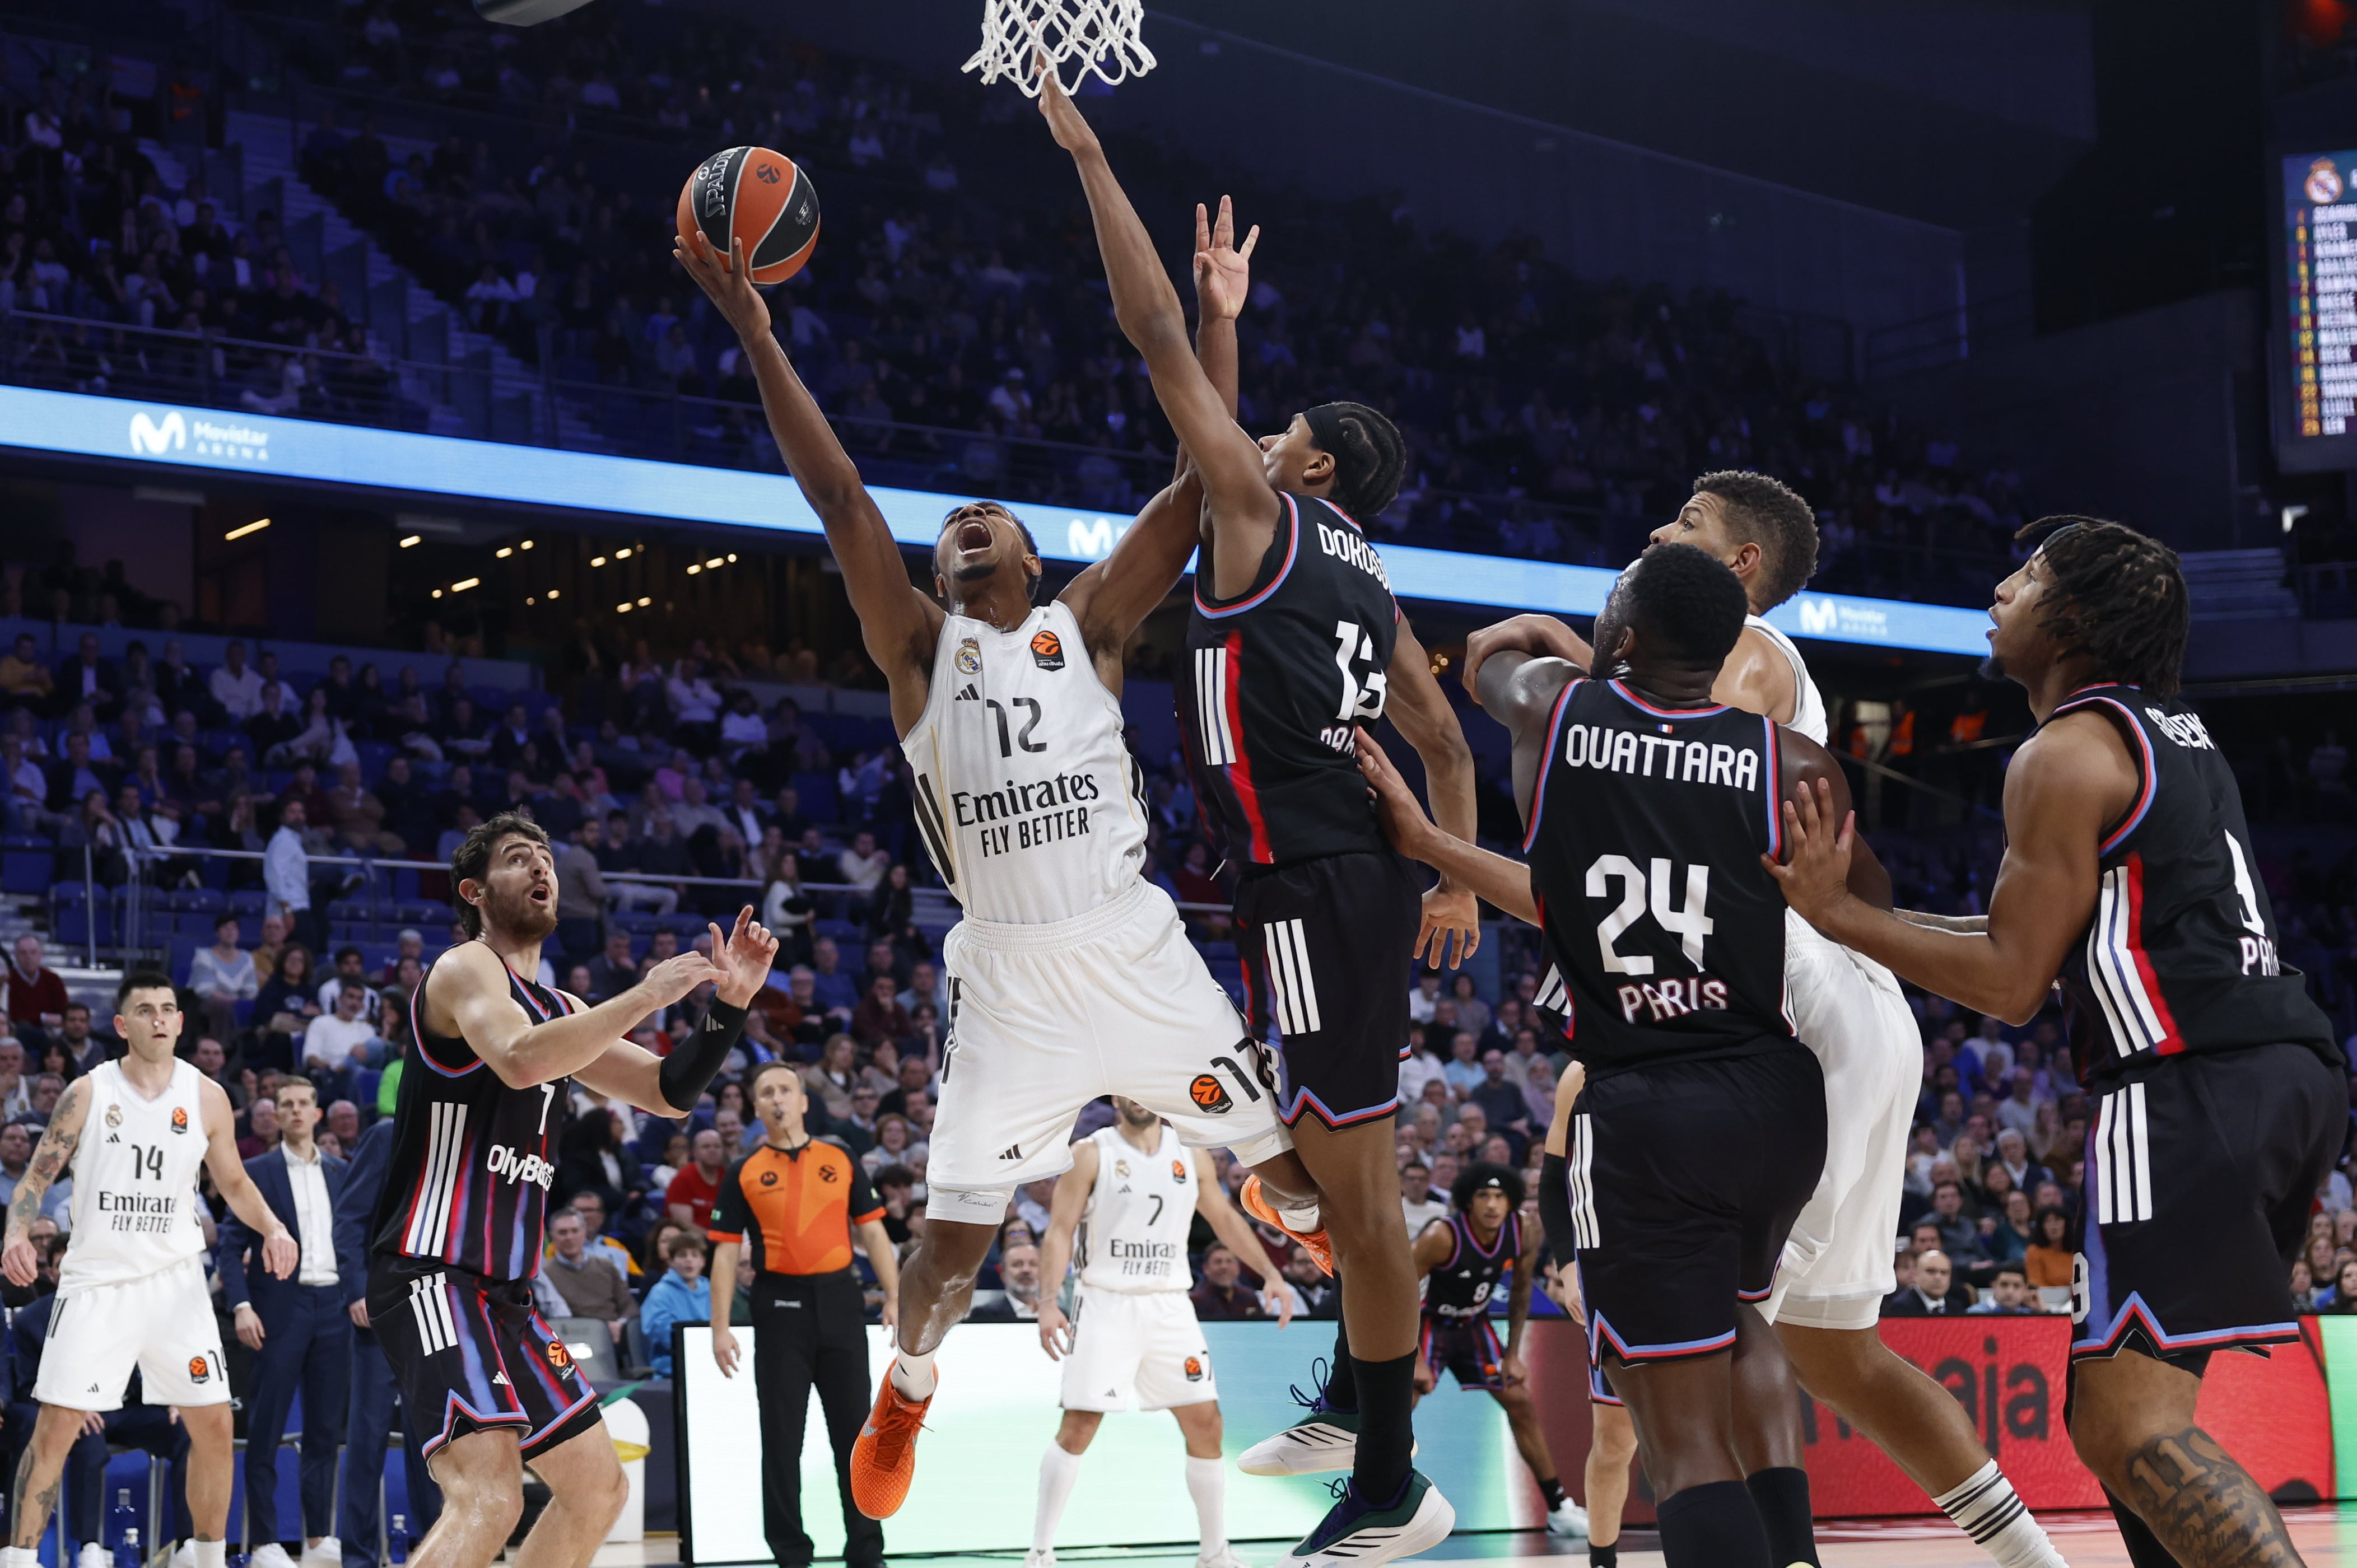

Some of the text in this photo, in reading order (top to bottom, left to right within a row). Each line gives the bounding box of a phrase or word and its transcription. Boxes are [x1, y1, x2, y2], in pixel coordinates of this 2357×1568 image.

[193, 421, 268, 446] Movistar
[197, 441, 269, 461] ARENA
[986, 697, 1047, 758] 12
[1566, 724, 1759, 792] OUATTARA
[951, 771, 1099, 827] Emirates
[981, 806, 1089, 858] FLY BETTER
[1586, 854, 1714, 976] 24
[1617, 977, 1729, 1024] PARIS
[131, 1145, 164, 1180] 14
[112, 1215, 132, 1231] FLY
[1148, 1194, 1163, 1226] 7
[1122, 1260, 1142, 1275] FLY
[1473, 1281, 1490, 1303] 8
